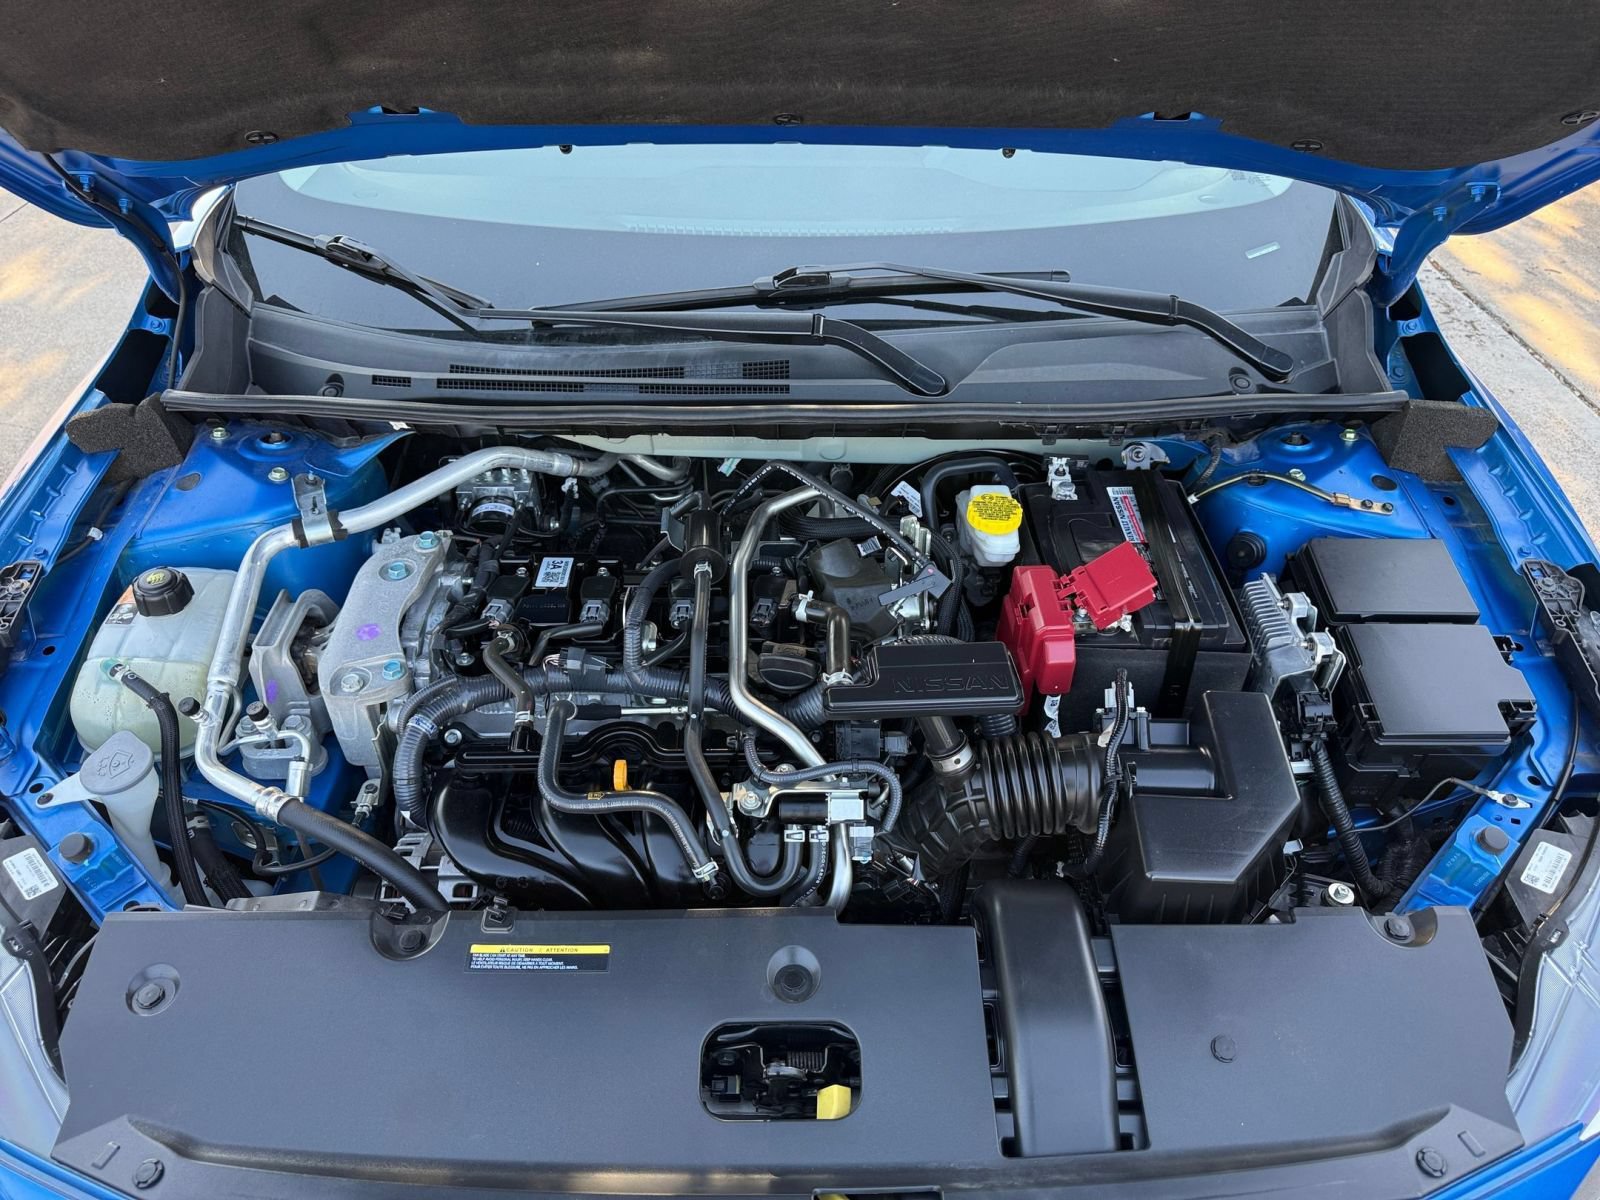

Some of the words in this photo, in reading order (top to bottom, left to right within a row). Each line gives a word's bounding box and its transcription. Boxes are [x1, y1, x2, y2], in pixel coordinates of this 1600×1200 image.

[1112, 496, 1126, 520] NISSAN
[550, 559, 564, 570] 3A
[892, 671, 1009, 694] NISSAN
